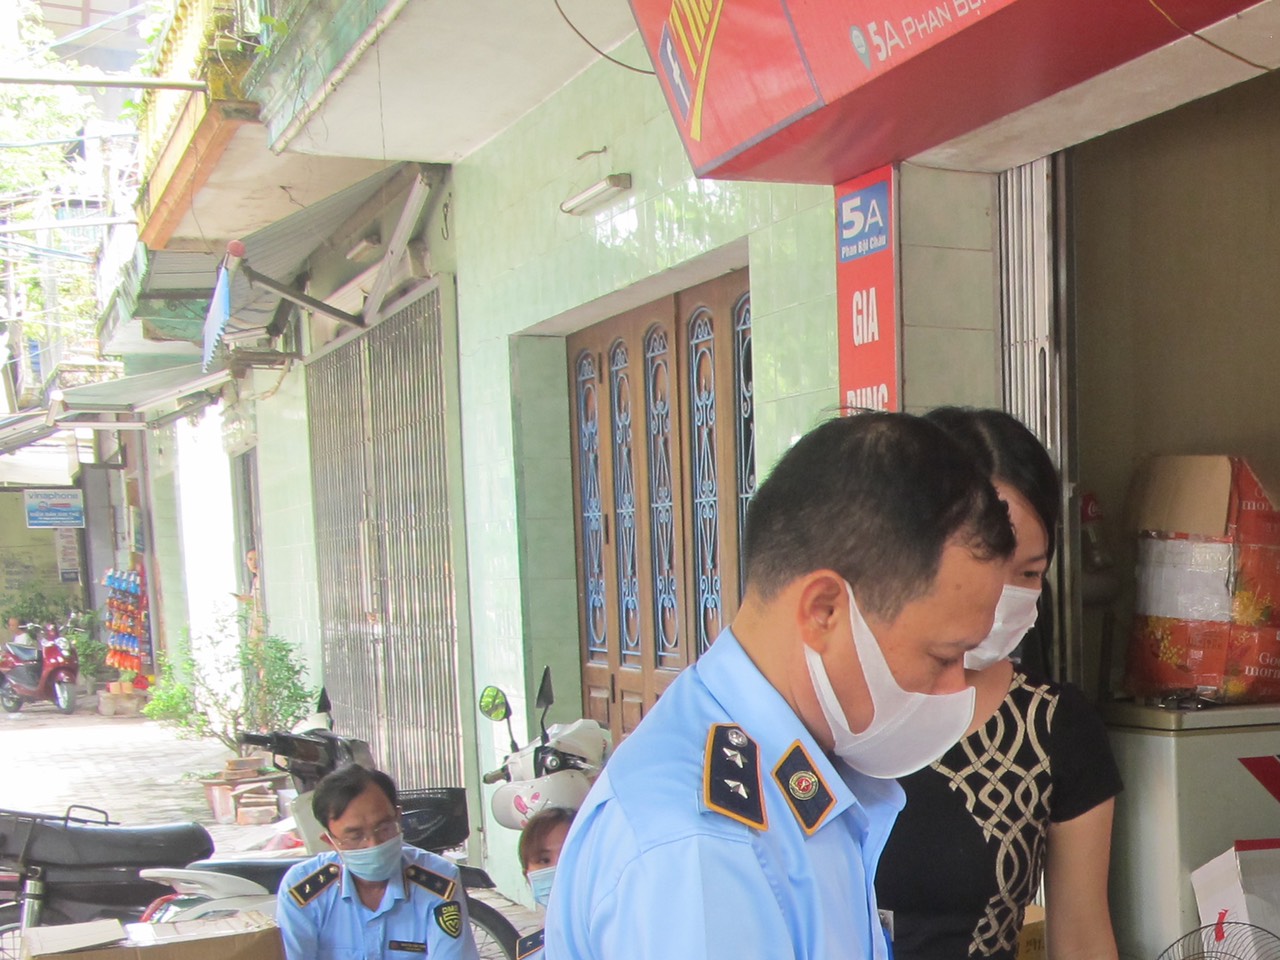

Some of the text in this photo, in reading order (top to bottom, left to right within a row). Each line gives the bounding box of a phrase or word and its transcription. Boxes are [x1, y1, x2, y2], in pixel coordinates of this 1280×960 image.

[867, 19, 905, 62] 5A
[902, 2, 952, 45] PHAN
[841, 196, 884, 240] 5A
[852, 287, 879, 347] GIA
[28, 492, 79, 501] vinaphone
